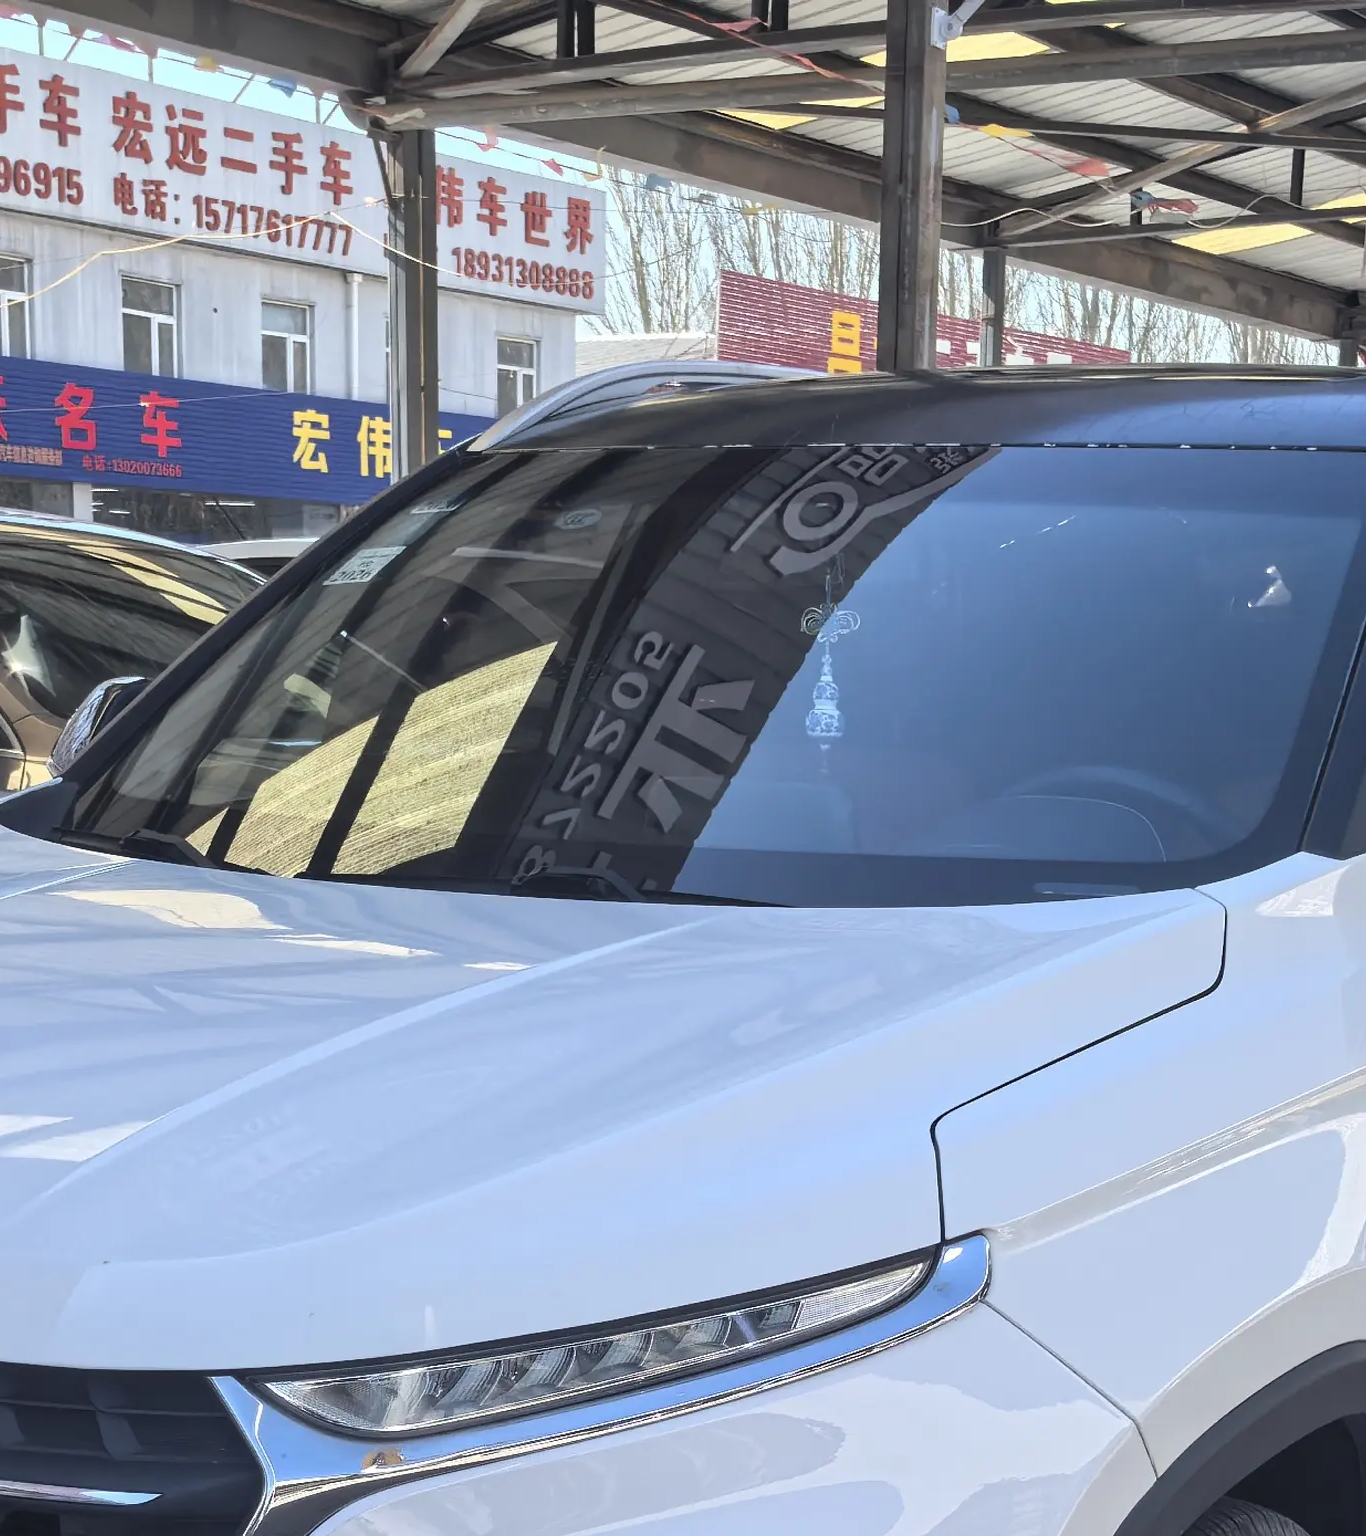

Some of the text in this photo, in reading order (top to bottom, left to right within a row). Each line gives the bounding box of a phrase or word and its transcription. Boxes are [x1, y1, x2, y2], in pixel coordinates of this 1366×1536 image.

[112, 90, 354, 206] 宏远二手车
[451, 246, 594, 300] 18931308888
